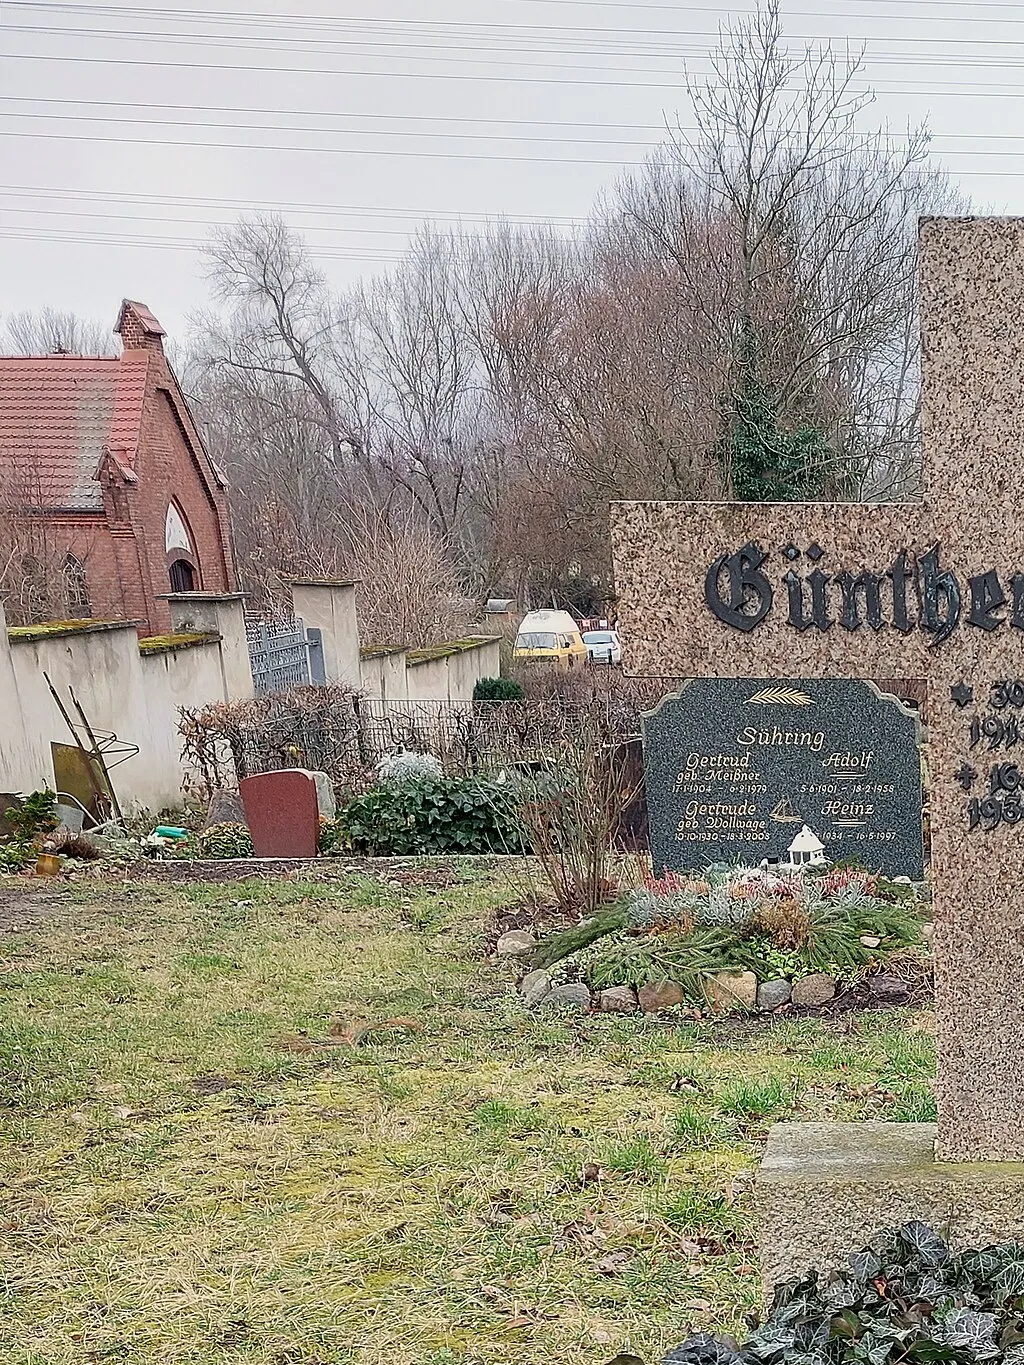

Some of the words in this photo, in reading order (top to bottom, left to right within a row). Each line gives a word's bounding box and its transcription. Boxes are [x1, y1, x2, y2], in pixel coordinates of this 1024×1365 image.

[737, 726, 825, 752] Sühring
[685, 751, 751, 771] Gertrud
[821, 751, 874, 769] Adolf
[704, 769, 760, 783] Meißner
[684, 800, 757, 820] Gertrude
[820, 800, 875, 815] Heinz
